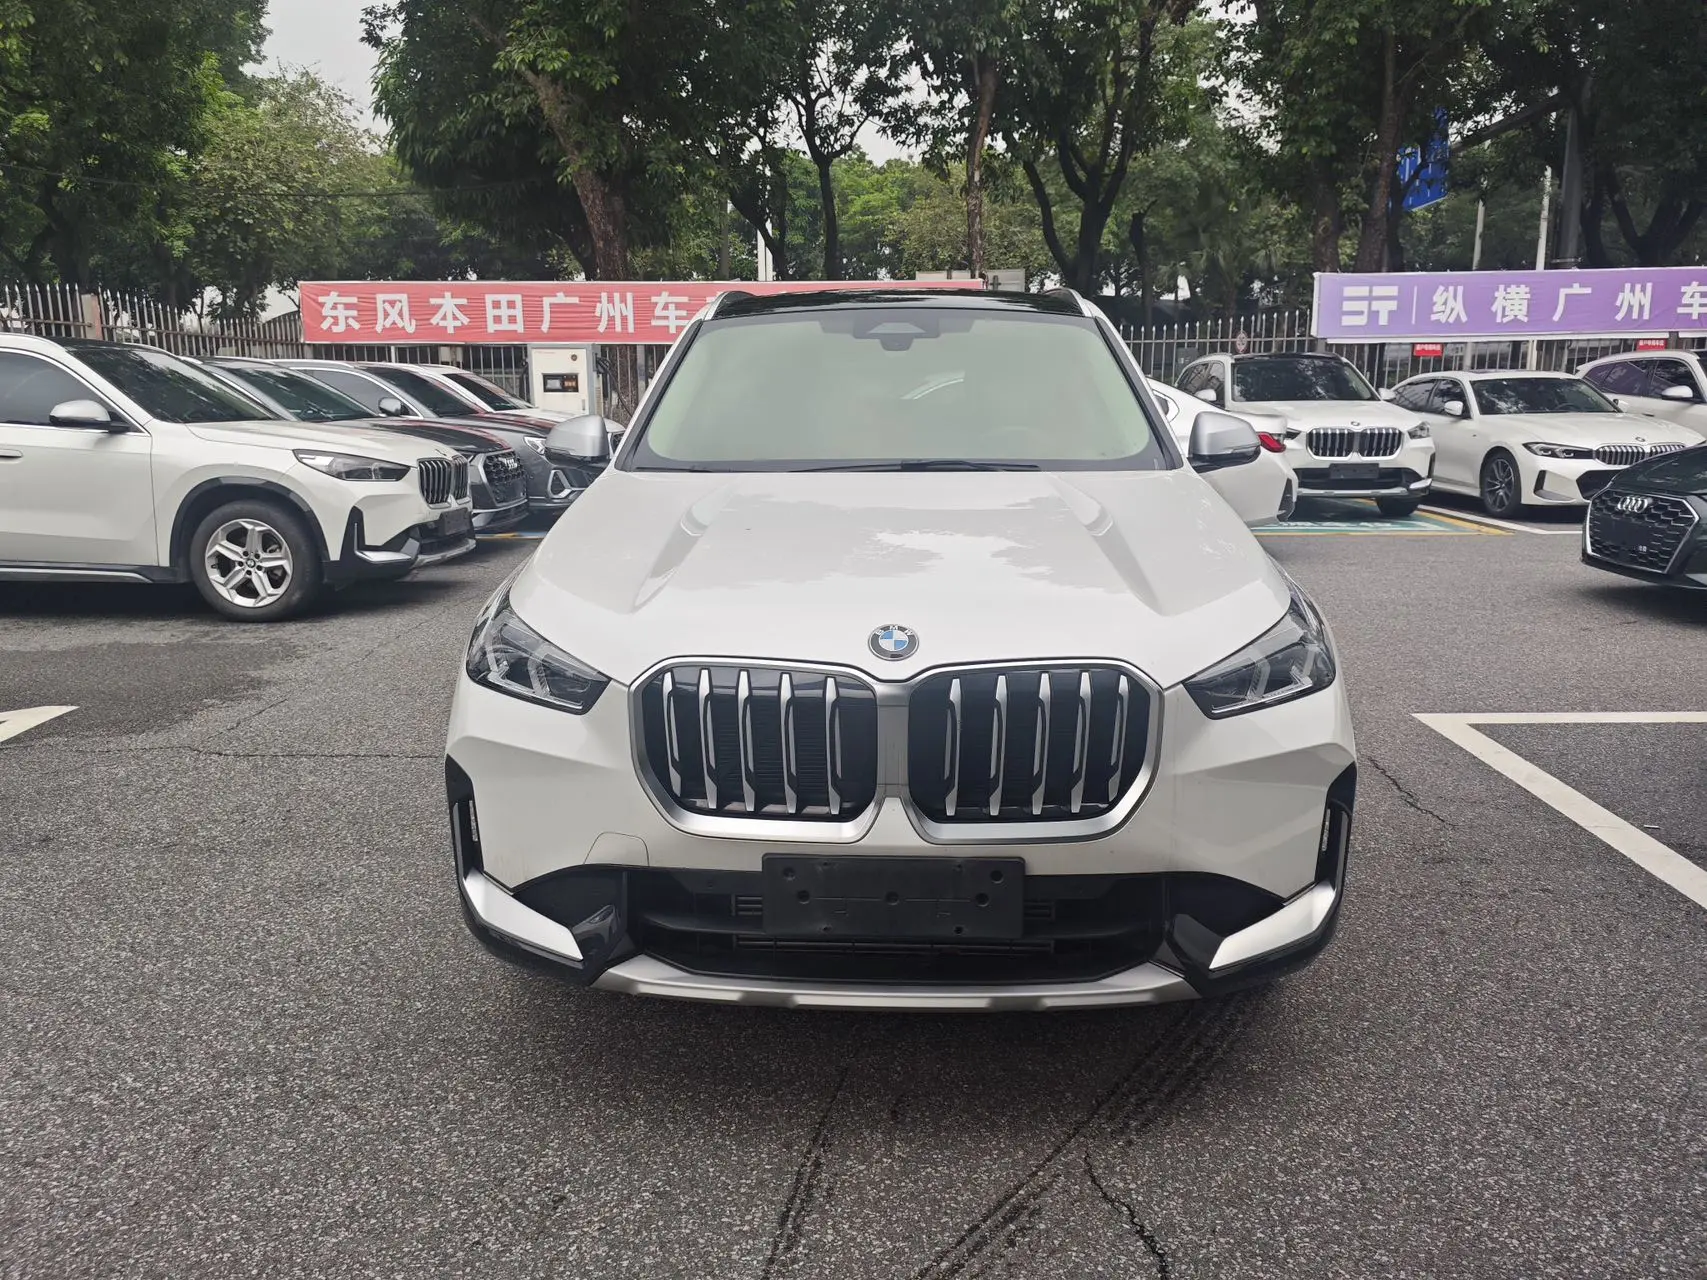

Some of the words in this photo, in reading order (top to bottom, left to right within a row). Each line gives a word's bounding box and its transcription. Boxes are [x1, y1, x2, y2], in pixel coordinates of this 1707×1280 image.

[318, 291, 722, 333] 东风本田广州车
